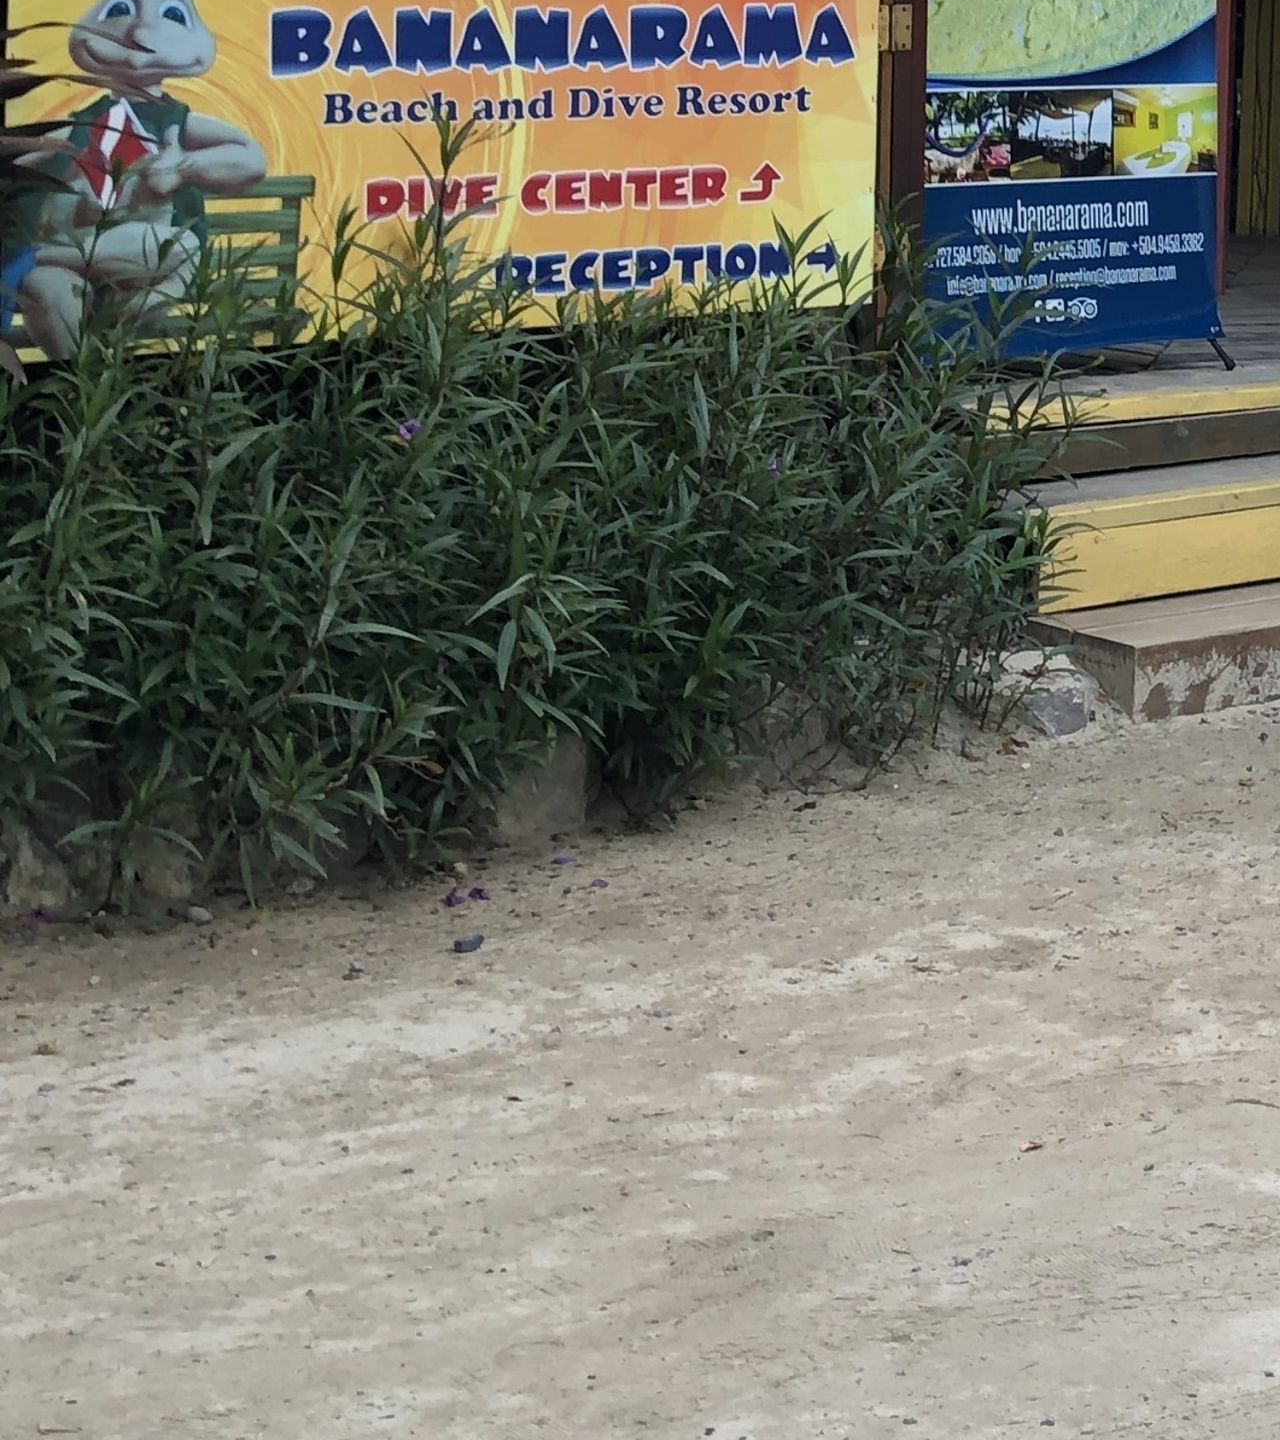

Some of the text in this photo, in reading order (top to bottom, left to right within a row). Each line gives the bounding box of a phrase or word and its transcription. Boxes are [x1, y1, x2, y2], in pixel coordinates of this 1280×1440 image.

[269, 2, 856, 78] BANANARAMA
[323, 84, 812, 126] Beach and Dive Resort
[364, 165, 728, 222] DIVE CENTER
[972, 199, 1149, 236] www.bananarama.com
